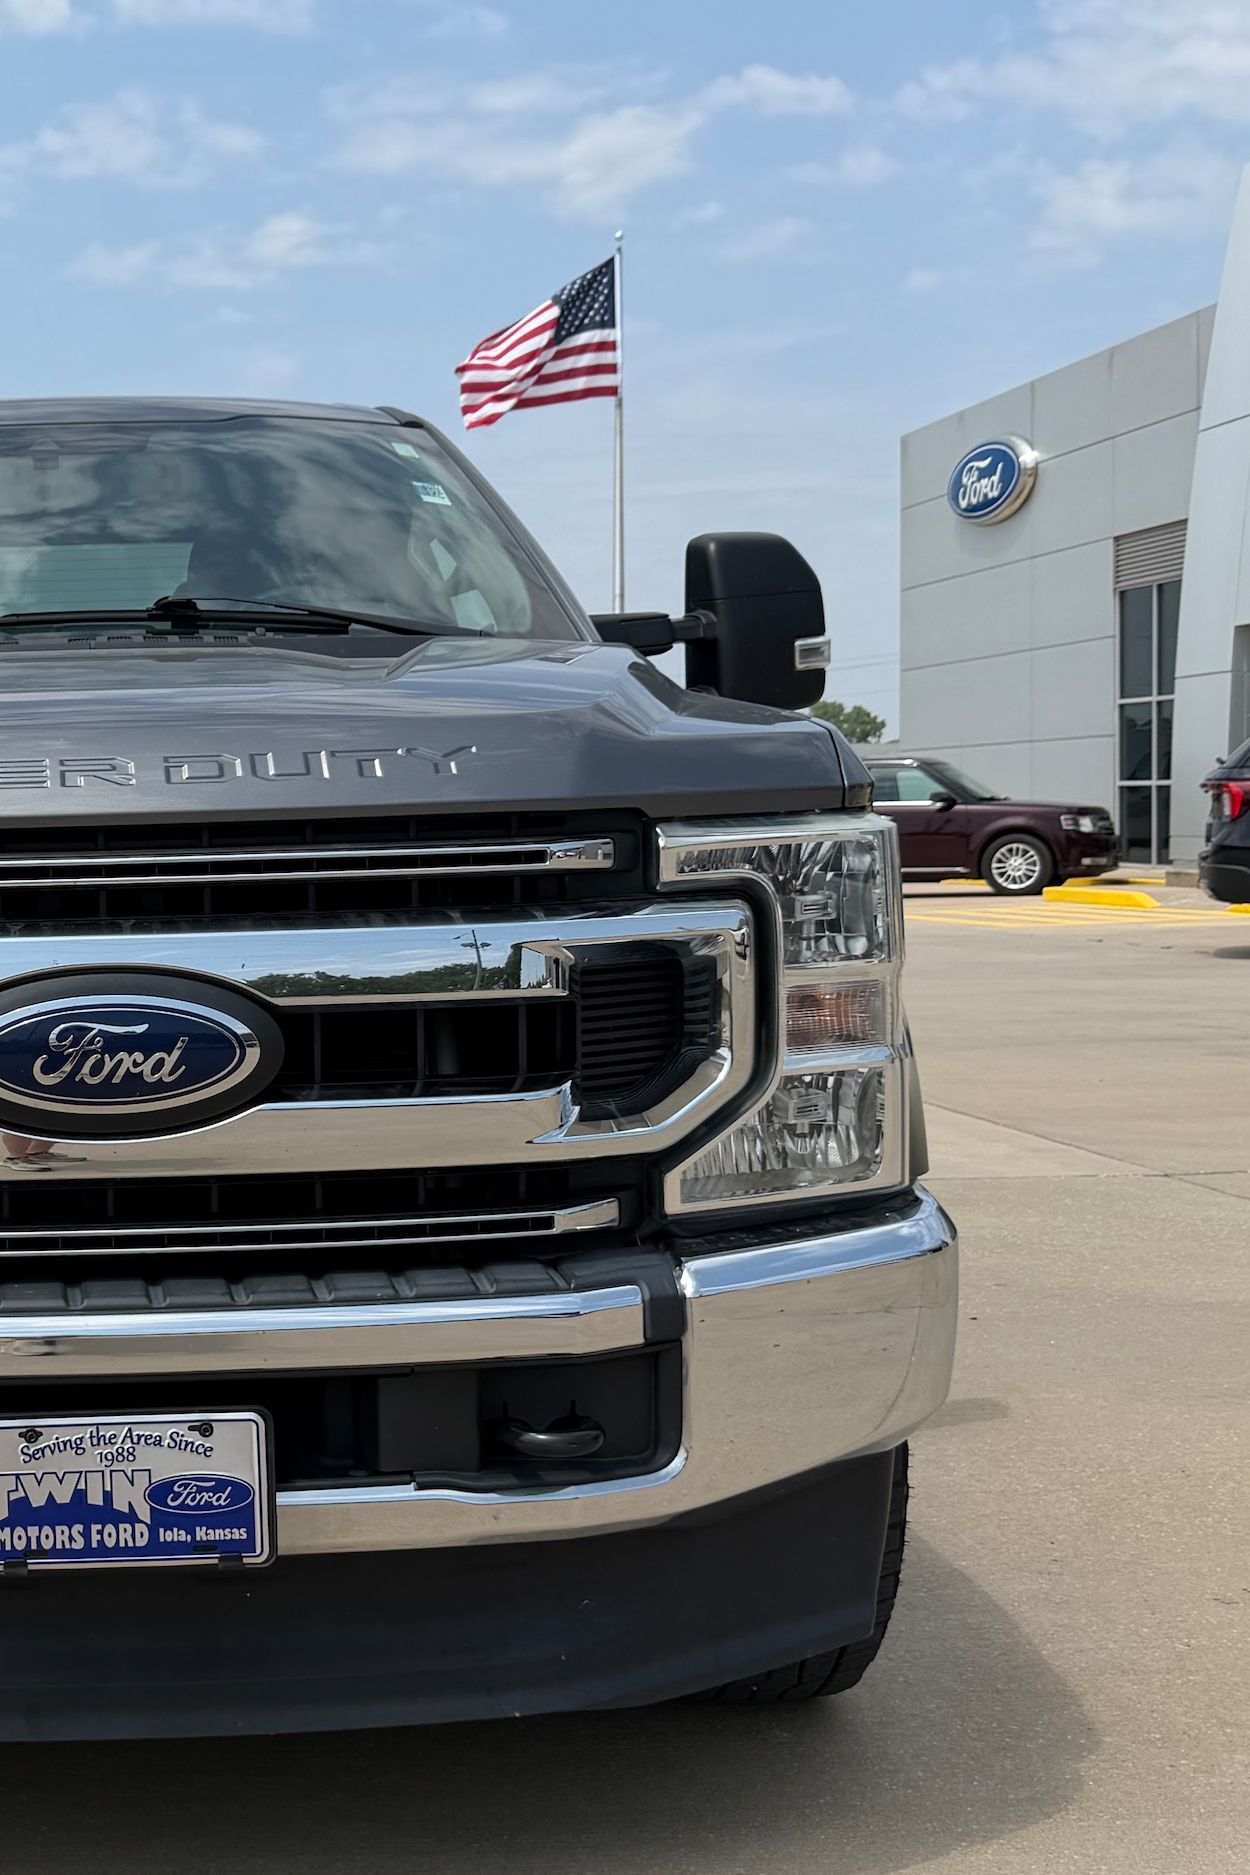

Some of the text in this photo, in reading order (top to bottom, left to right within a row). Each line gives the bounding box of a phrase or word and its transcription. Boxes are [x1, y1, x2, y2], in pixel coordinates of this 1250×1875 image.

[958, 456, 1004, 510] Ford
[163, 745, 477, 784] DUTY
[32, 1021, 189, 1086] Ford
[20, 1425, 214, 1464] Serving the Area Since
[96, 1446, 137, 1467] 1988
[166, 1479, 232, 1507] Ford
[90, 1522, 150, 1549] FORD
[158, 1525, 248, 1543] Iola, Kansas
